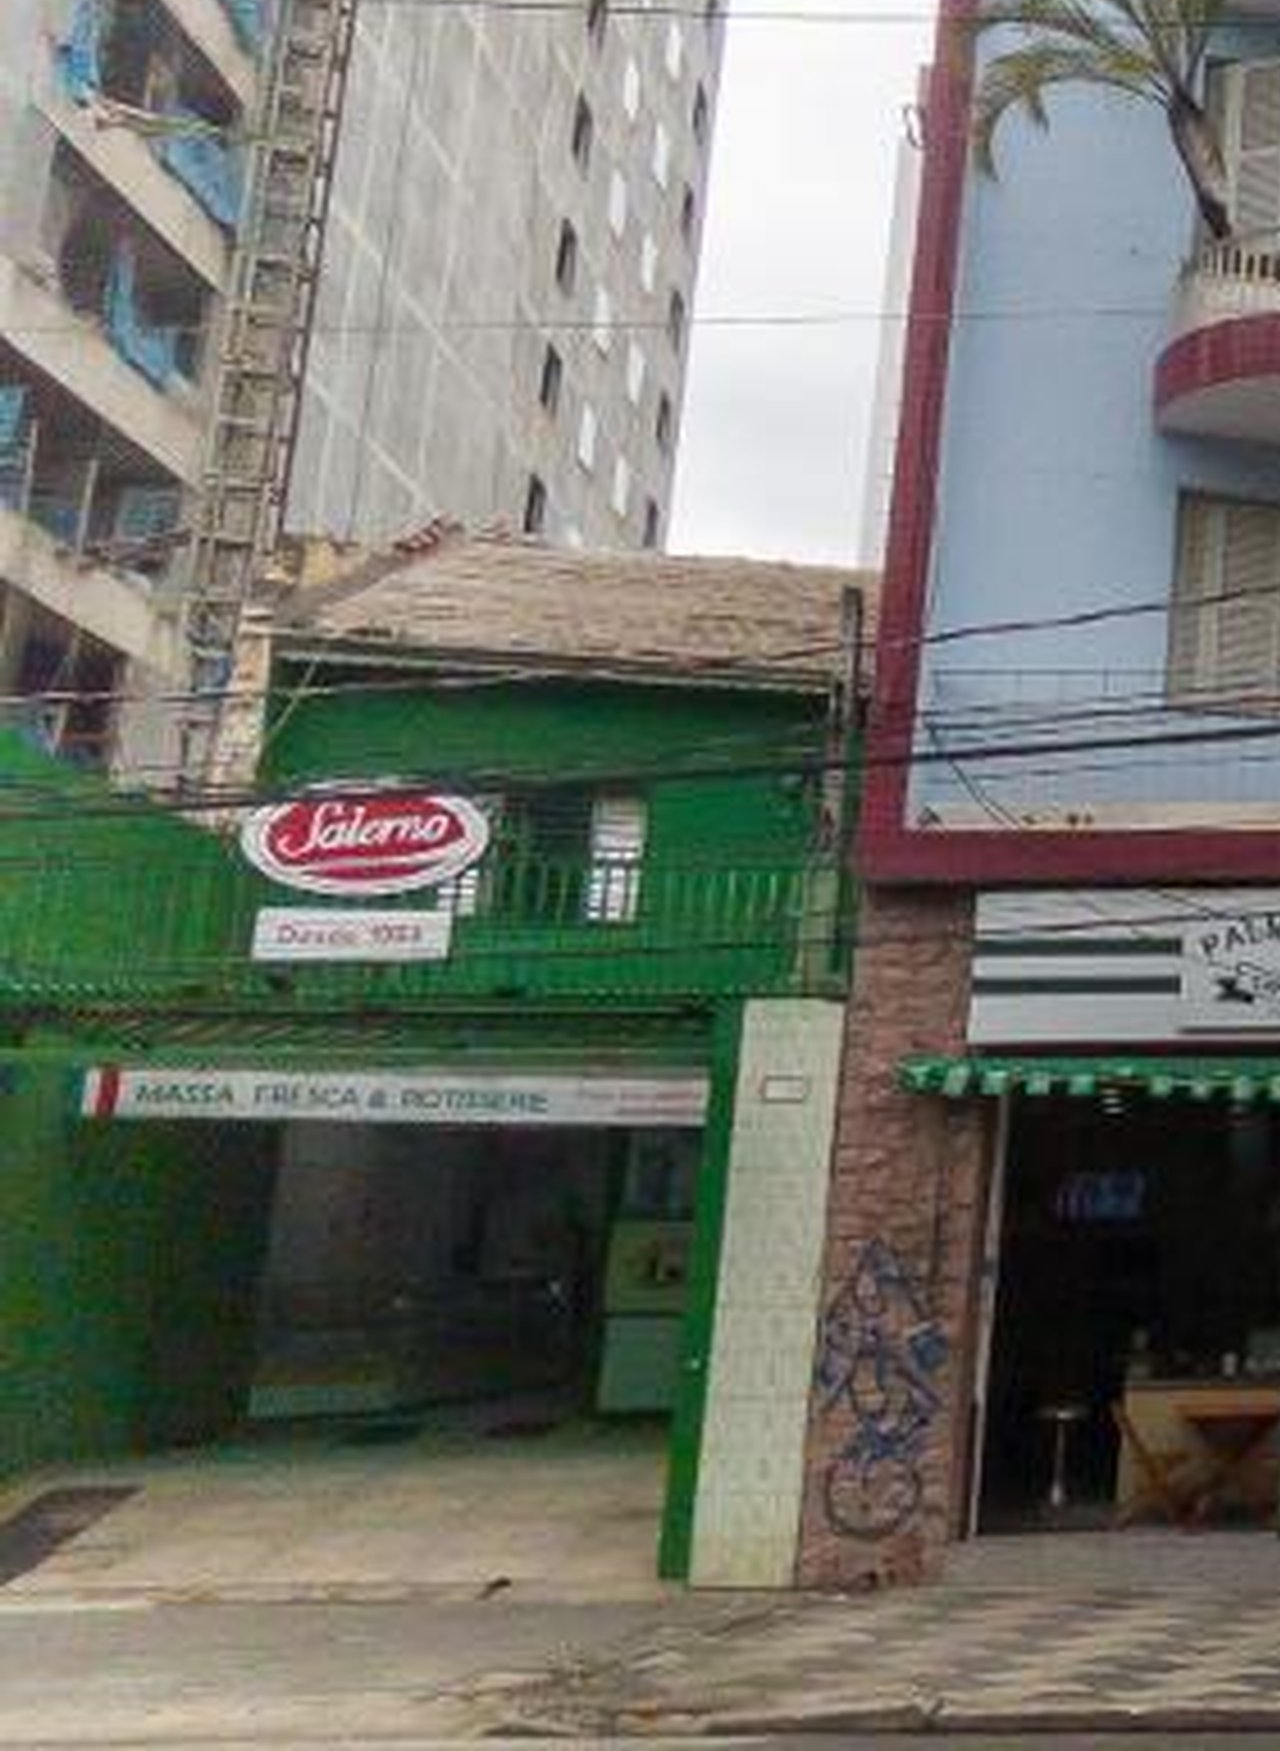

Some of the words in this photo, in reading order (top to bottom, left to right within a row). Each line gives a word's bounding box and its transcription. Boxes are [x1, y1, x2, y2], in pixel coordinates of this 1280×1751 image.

[276, 801, 449, 859] Salerno
[135, 1083, 234, 1103] MASSA
[253, 1084, 359, 1108] FRESCA
